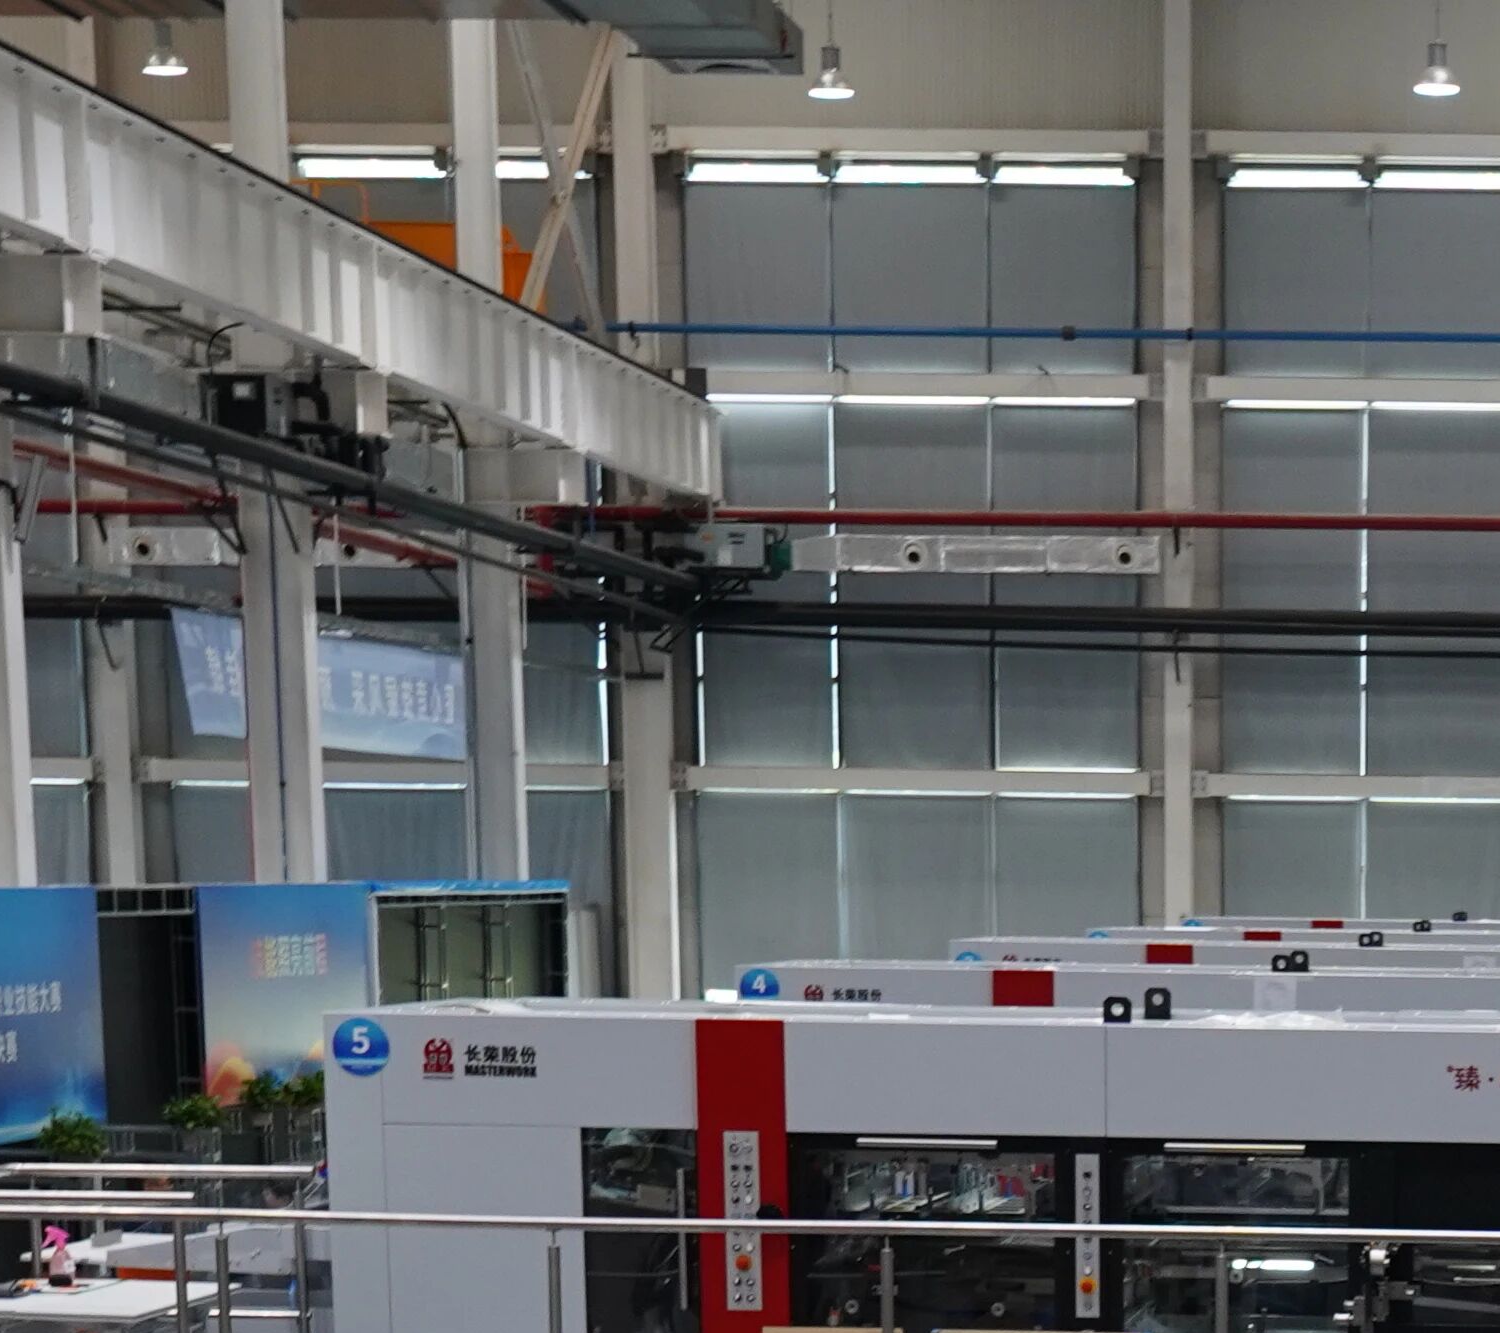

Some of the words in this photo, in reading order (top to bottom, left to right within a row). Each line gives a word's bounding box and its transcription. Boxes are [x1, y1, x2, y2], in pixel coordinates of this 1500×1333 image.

[751, 975, 767, 994] 4
[351, 1026, 371, 1054] 5
[464, 1044, 538, 1064] 长荣股份
[464, 1064, 538, 1078] MASTERWORK
